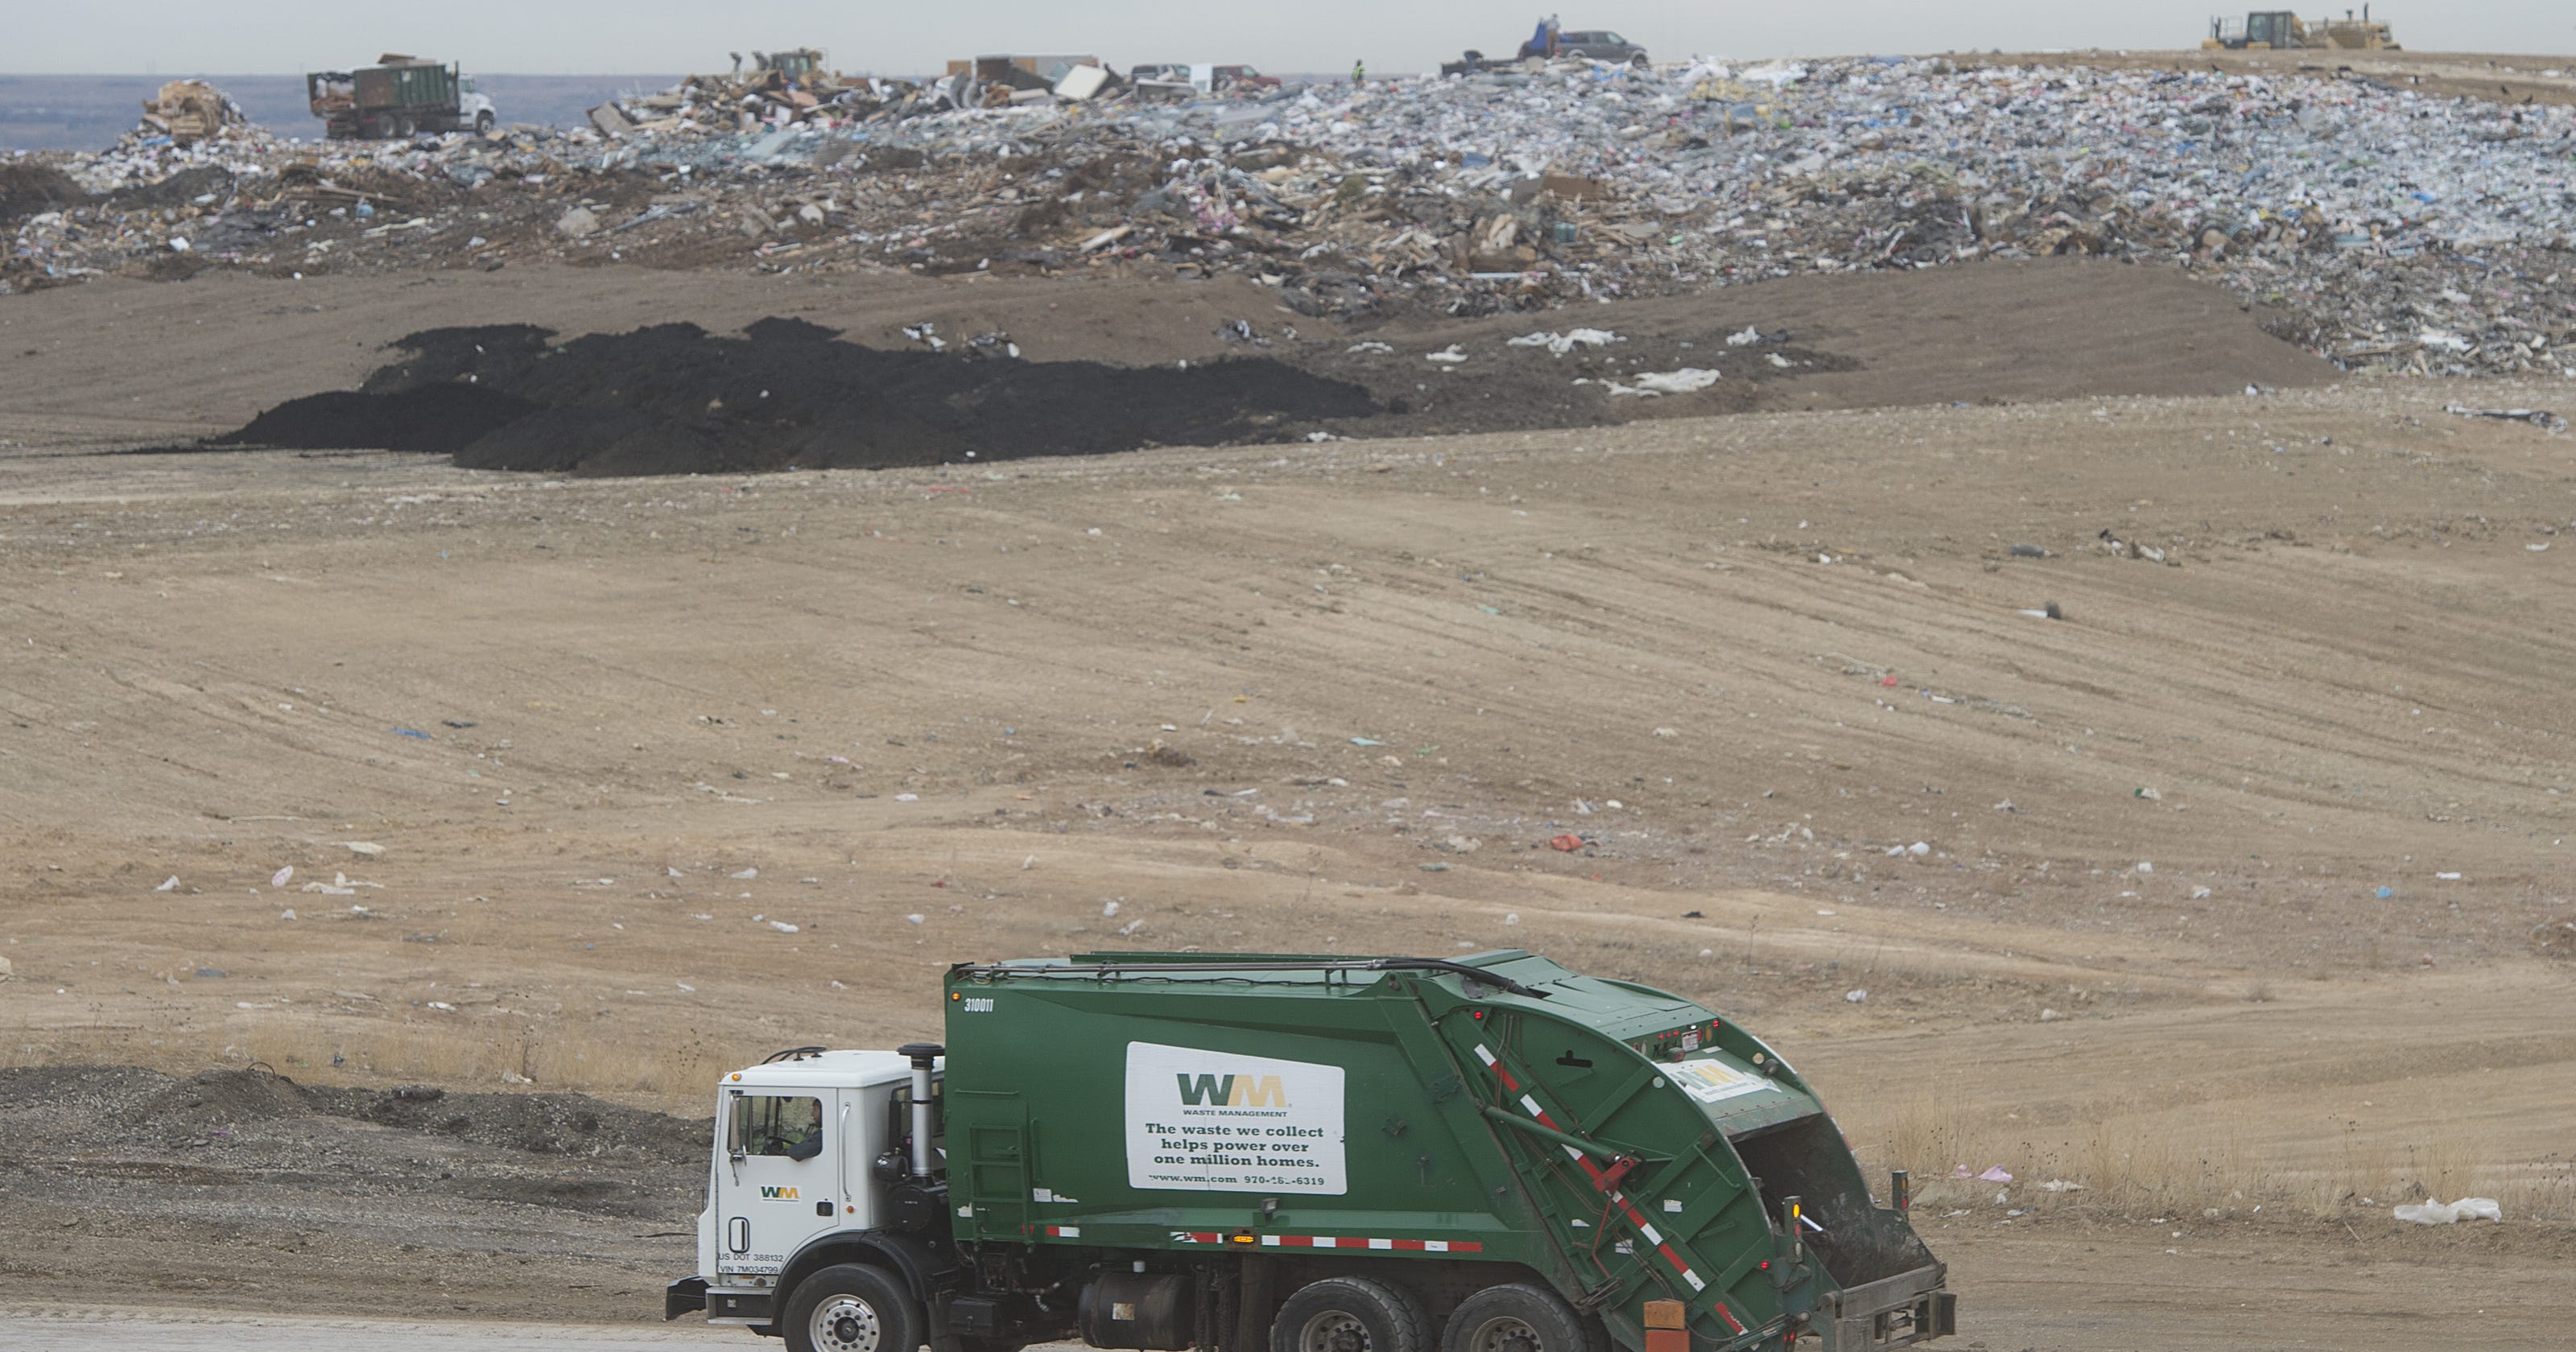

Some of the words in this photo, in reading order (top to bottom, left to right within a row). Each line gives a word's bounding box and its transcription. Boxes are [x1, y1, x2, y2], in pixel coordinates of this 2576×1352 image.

[964, 998, 993, 1012] 310011
[1177, 1074, 1286, 1107] WM
[1146, 1123, 1176, 1134] The
[1182, 1126, 1231, 1135] waste
[1236, 1127, 1260, 1136] we
[1265, 1126, 1324, 1137] collect
[1162, 1139, 1208, 1152] helps
[1213, 1142, 1266, 1152] power
[1272, 1144, 1309, 1152] over
[1154, 1156, 1185, 1164] one
[1191, 1155, 1252, 1165] million
[1257, 1156, 1319, 1167] homes.
[761, 1186, 799, 1198] WM
